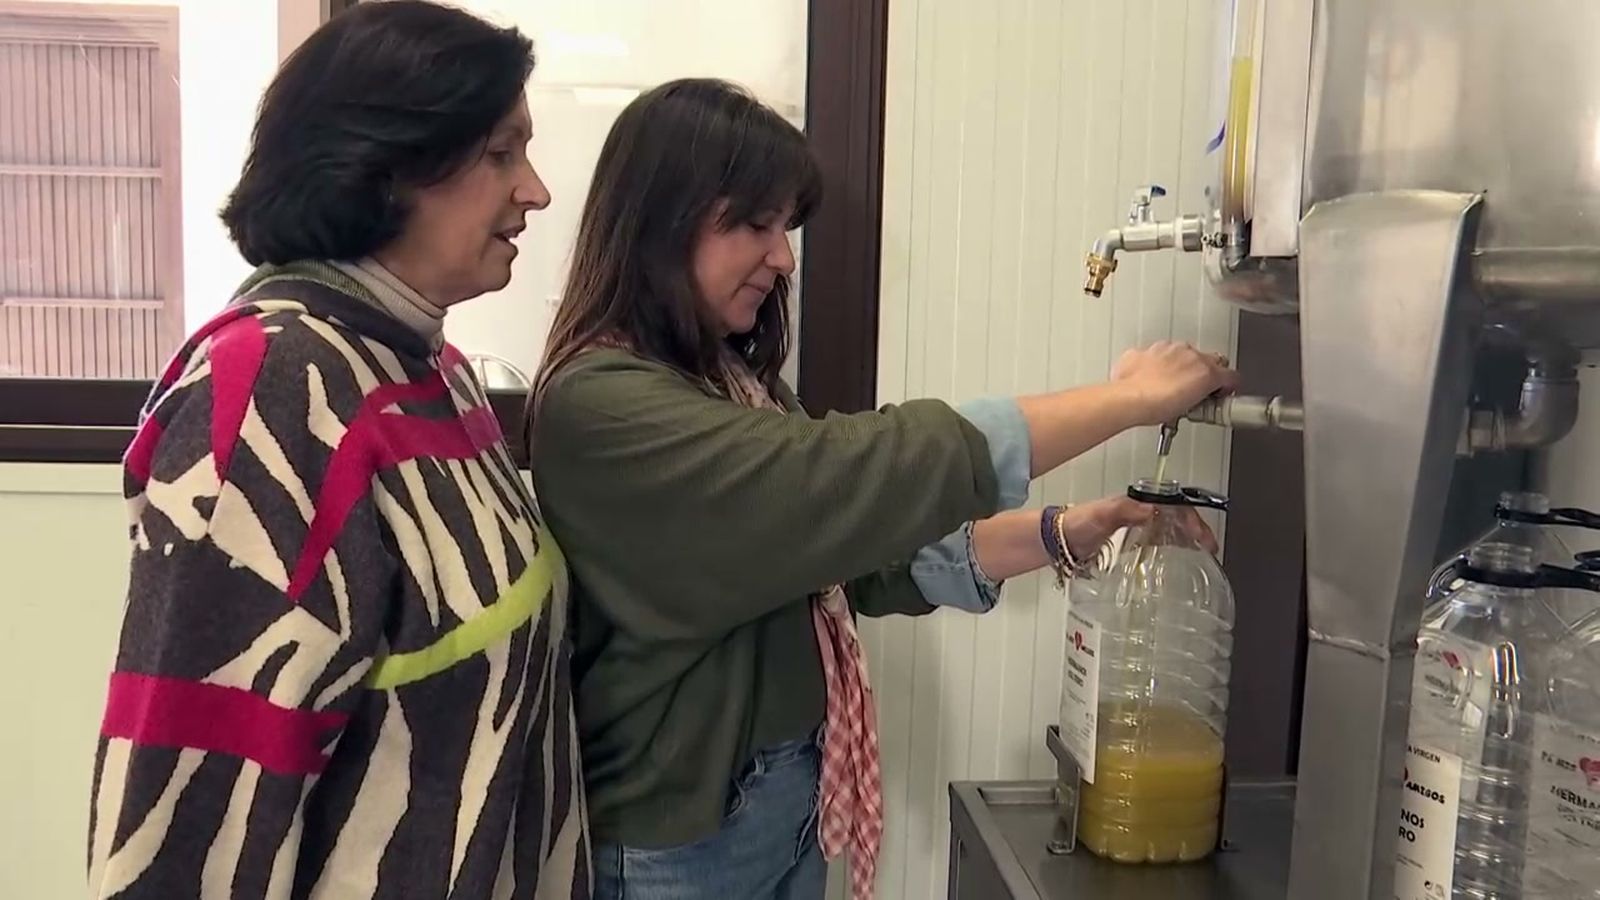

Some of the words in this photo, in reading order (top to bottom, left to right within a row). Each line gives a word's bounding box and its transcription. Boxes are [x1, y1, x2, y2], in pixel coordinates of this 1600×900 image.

[1413, 746, 1440, 763] VIRGEN
[1406, 781, 1445, 804] AMIGOS
[1400, 808, 1425, 829] NOS
